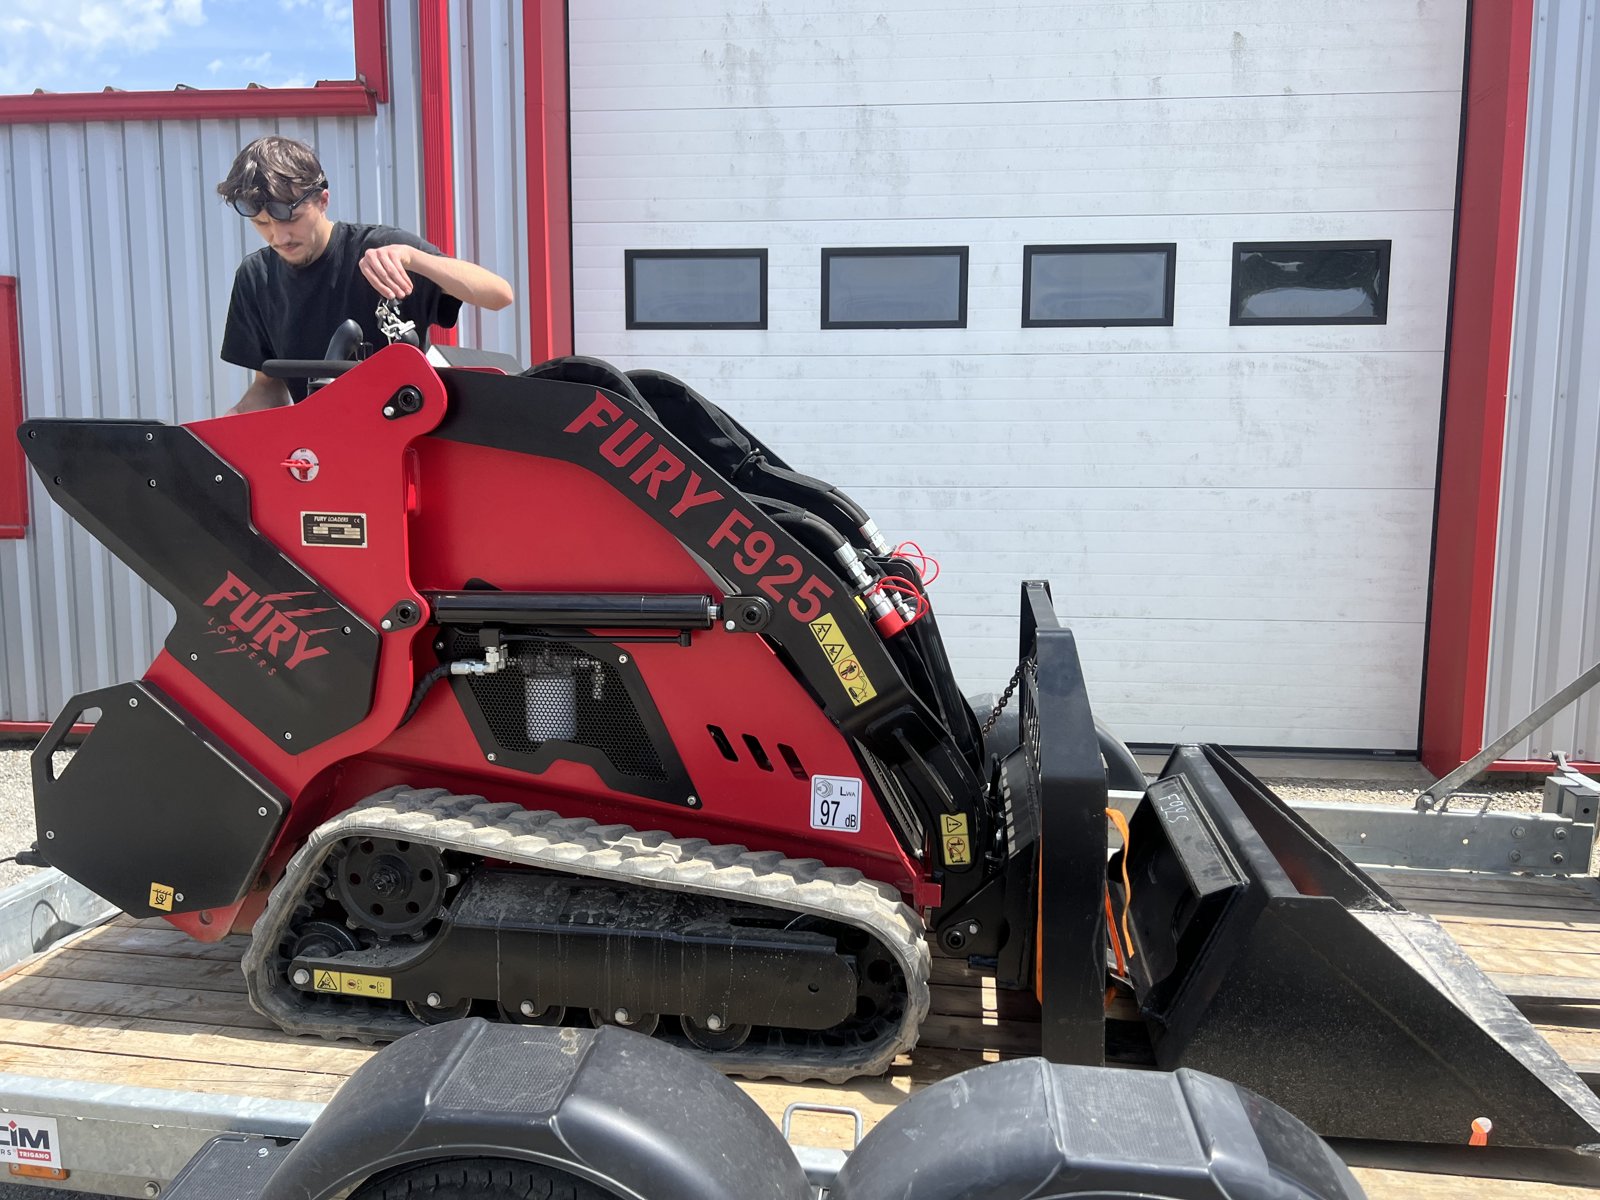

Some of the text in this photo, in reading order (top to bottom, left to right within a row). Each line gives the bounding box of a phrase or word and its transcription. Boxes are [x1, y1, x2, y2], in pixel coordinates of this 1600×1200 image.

[563, 390, 834, 623] FURY F925
[203, 570, 330, 670] FURY
[207, 617, 277, 676] LOADERS
[820, 799, 857, 828] 97 dB
